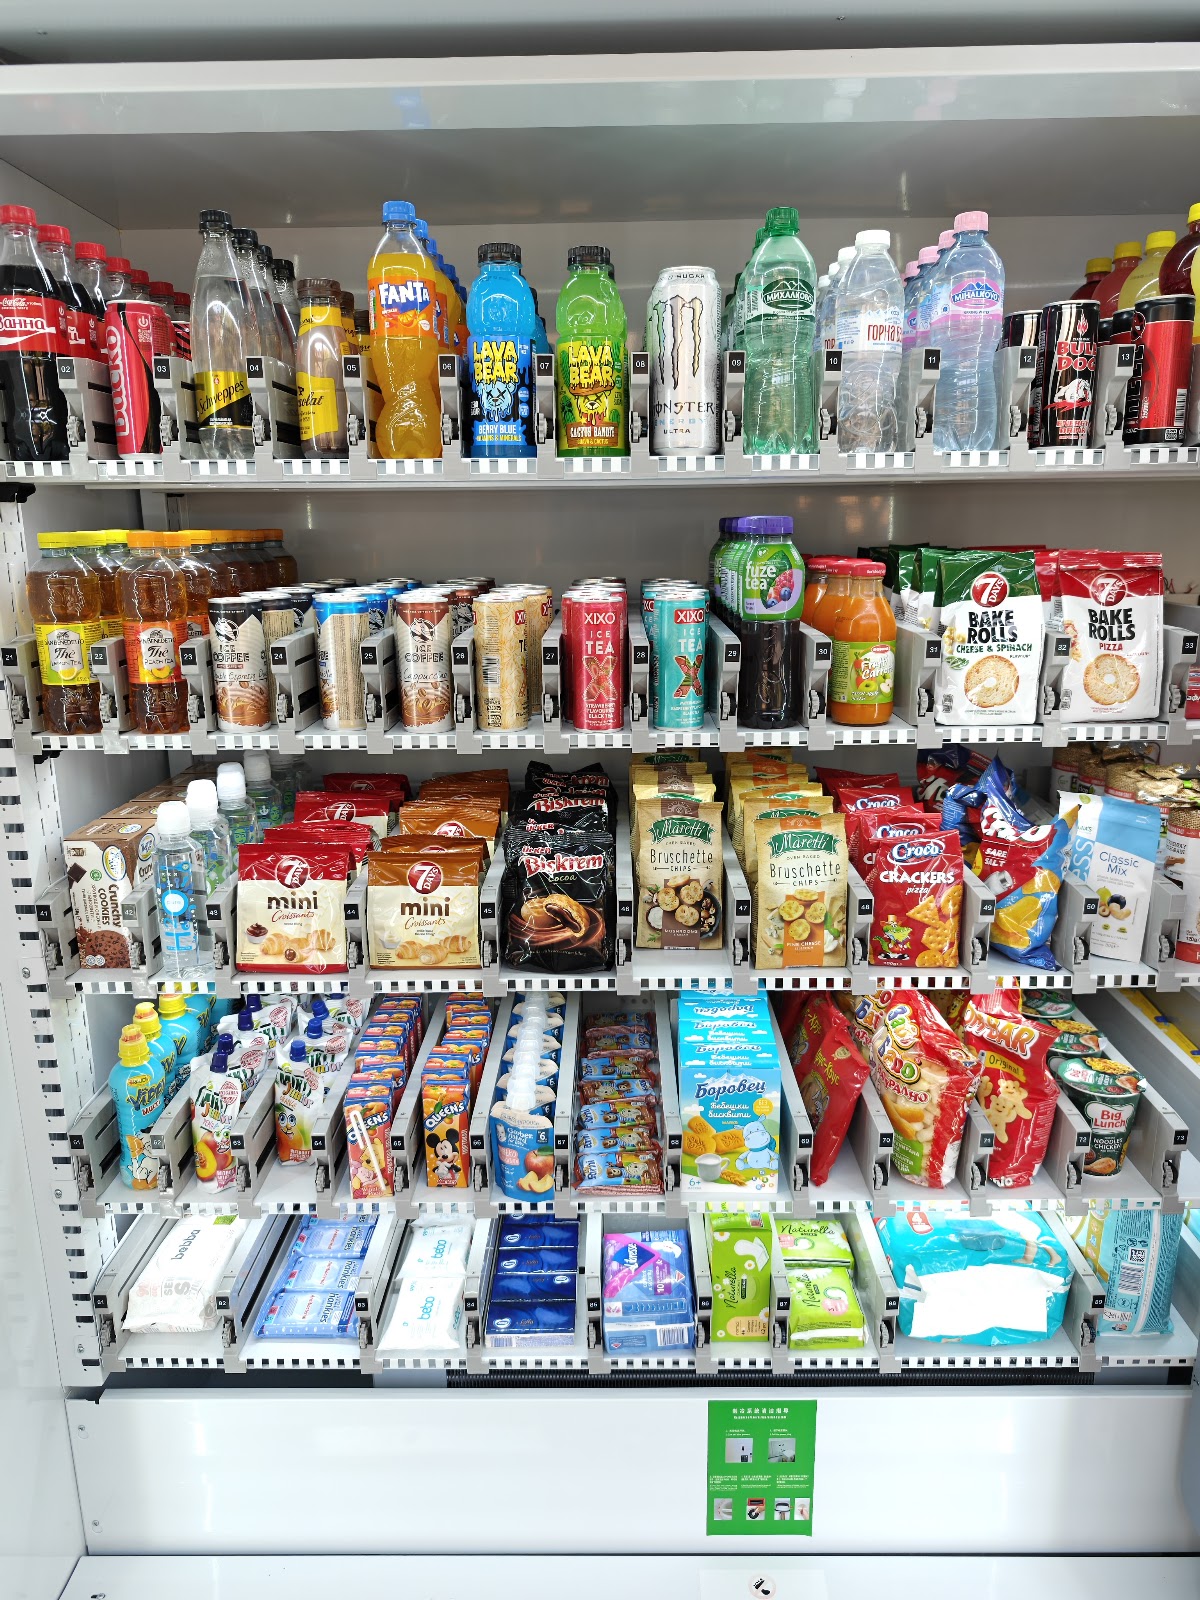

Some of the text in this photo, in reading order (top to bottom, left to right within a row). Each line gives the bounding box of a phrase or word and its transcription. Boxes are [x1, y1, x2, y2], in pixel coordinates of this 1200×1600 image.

[379, 280, 430, 304] FANTA
[765, 291, 815, 303] МИХАЛКОВО
[953, 291, 1000, 303] MIHALKOVO
[473, 341, 518, 363] LAVA
[568, 345, 613, 367] LAVA
[1121, 353, 1130, 361] 13
[156, 365, 167, 373] 03
[249, 364, 259, 372] 04
[346, 364, 357, 372] 05
[442, 363, 452, 371] 06
[635, 360, 646, 368] 08
[474, 361, 519, 384] BEAR
[569, 366, 614, 389] BEAR
[199, 380, 246, 414] Schweppes
[479, 424, 516, 435] BERRY BLUE
[746, 561, 777, 578] fuze
[746, 578, 768, 591] tea
[975, 577, 992, 604] 7
[988, 578, 1005, 603] DAYS
[1095, 577, 1113, 606] 7
[1104, 578, 1125, 604] DAYS
[584, 612, 616, 625] XIXO
[677, 610, 704, 623] XIXO
[968, 609, 1014, 627] BAKE
[1087, 608, 1133, 626] BAKE
[590, 631, 611, 639] ICE
[683, 628, 702, 636] ICE
[966, 627, 1018, 645] ROLLS
[1088, 624, 1137, 643] ROLLS
[219, 644, 236, 652] ICE
[415, 644, 433, 652] ICE
[585, 640, 615, 655] TEA
[678, 639, 704, 653] TEA
[956, 644, 1033, 654] CHEESE & SPINACH
[1099, 642, 1124, 653] PIZZA
[214, 652, 250, 663] COFFEE
[364, 652, 374, 660] 25
[405, 652, 444, 663] COFFEE
[636, 651, 646, 659] 28
[856, 797, 897, 811] Croco
[654, 820, 706, 840] Maretti
[876, 825, 919, 840] Croco
[776, 833, 829, 854] Maretti
[650, 848, 713, 864] Bruschette
[892, 841, 940, 862] Croco
[984, 847, 1008, 858] SARE
[520, 854, 606, 878] Biskrem
[984, 857, 1005, 867] SALT
[1098, 850, 1139, 869] Classic
[278, 858, 300, 887] 7
[411, 863, 432, 891] 7
[769, 861, 842, 879] Bruschette
[1106, 863, 1128, 877] Mix
[422, 867, 441, 890] DAYS
[549, 875, 579, 884] cocoa
[792, 879, 819, 888] CHIPS
[880, 871, 955, 885] CRACKERS
[906, 884, 930, 895] pizza
[97, 887, 110, 926] COOKIES
[108, 883, 122, 928] Crunchy
[268, 890, 318, 910] mini
[400, 896, 450, 917] mini
[271, 909, 315, 923] Croissants
[404, 916, 446, 930] Croissants
[988, 1055, 1020, 1074] Original
[694, 1078, 767, 1101] Боровец
[710, 1101, 750, 1111] Бебешки
[425, 1100, 467, 1128] QUEEN'S
[707, 1109, 752, 1119] бисквити
[1100, 1109, 1122, 1124] Big
[1093, 1117, 1127, 1129] Lunch
[1093, 1137, 1123, 1145] NOODLES
[1093, 1143, 1122, 1151] CHICKEN
[688, 1177, 701, 1187] 6+
[781, 1223, 836, 1237] Naturella
[724, 1266, 737, 1309] Naturella
